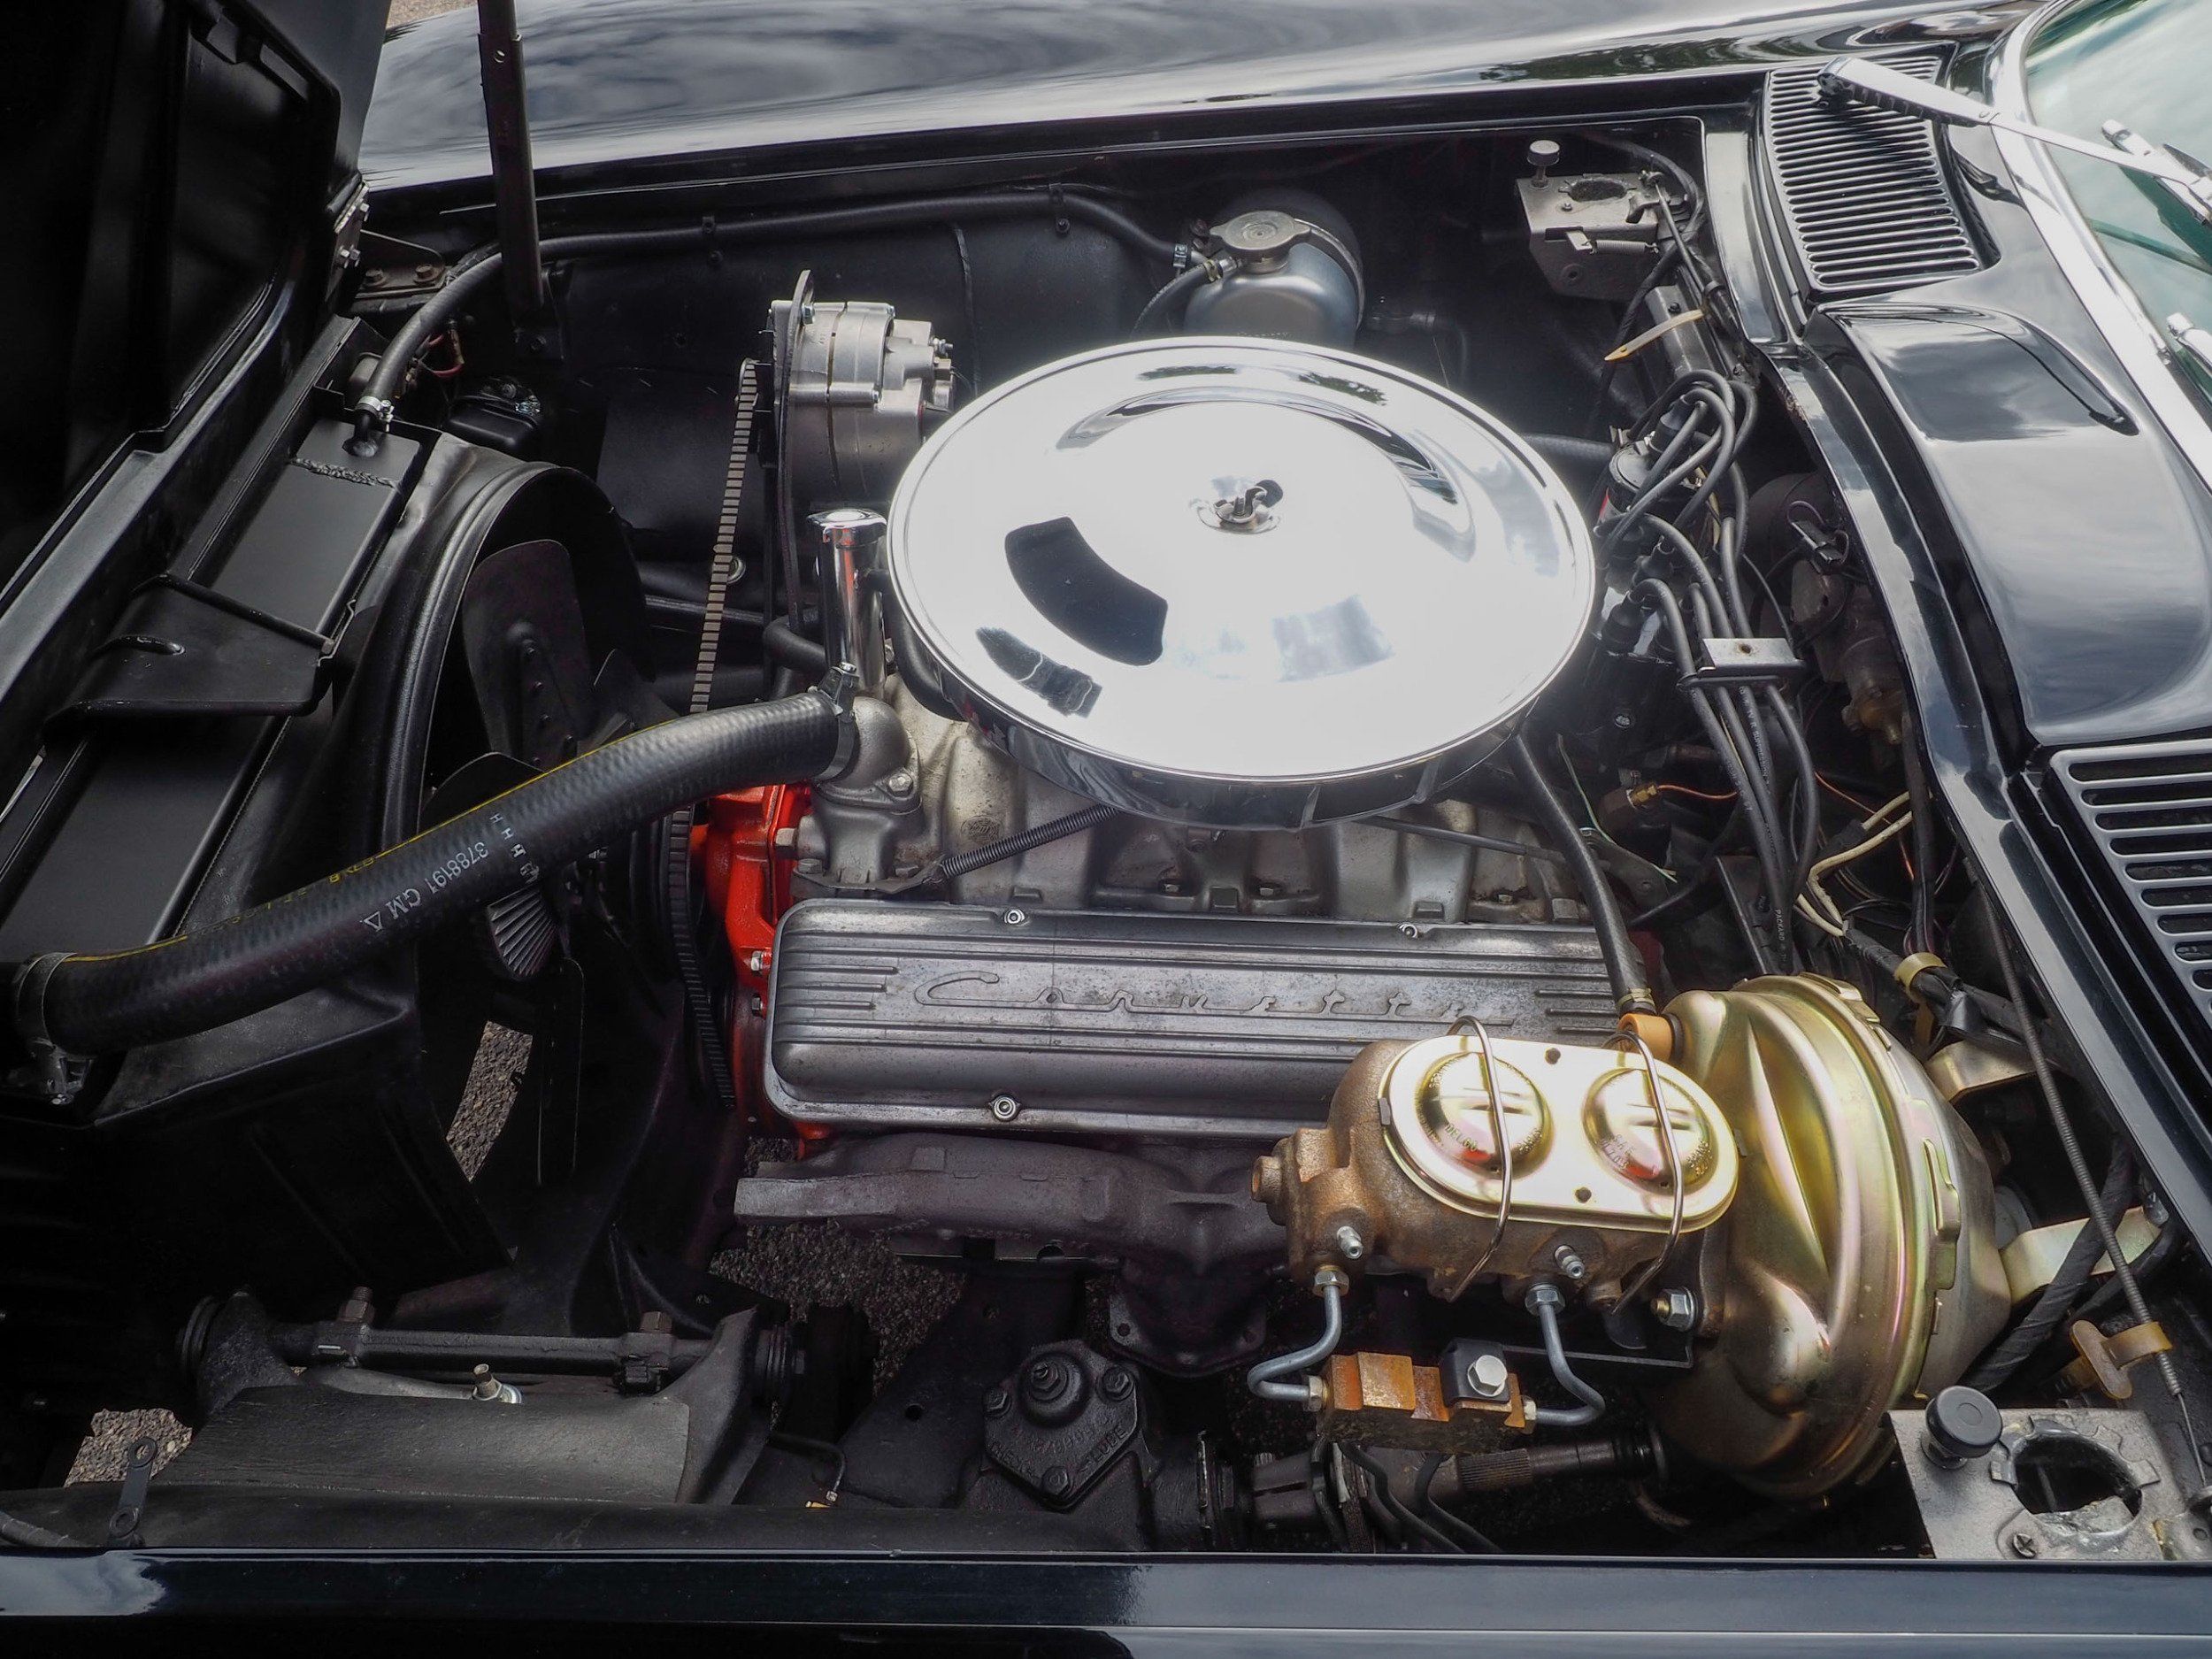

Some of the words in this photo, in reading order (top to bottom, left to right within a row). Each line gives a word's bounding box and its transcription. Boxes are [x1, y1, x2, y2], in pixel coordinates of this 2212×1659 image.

[424, 841, 489, 894] 3788191
[385, 887, 422, 921] GM
[1775, 909, 1786, 941] PACKARD
[1094, 1424, 1128, 1462] LUBE
